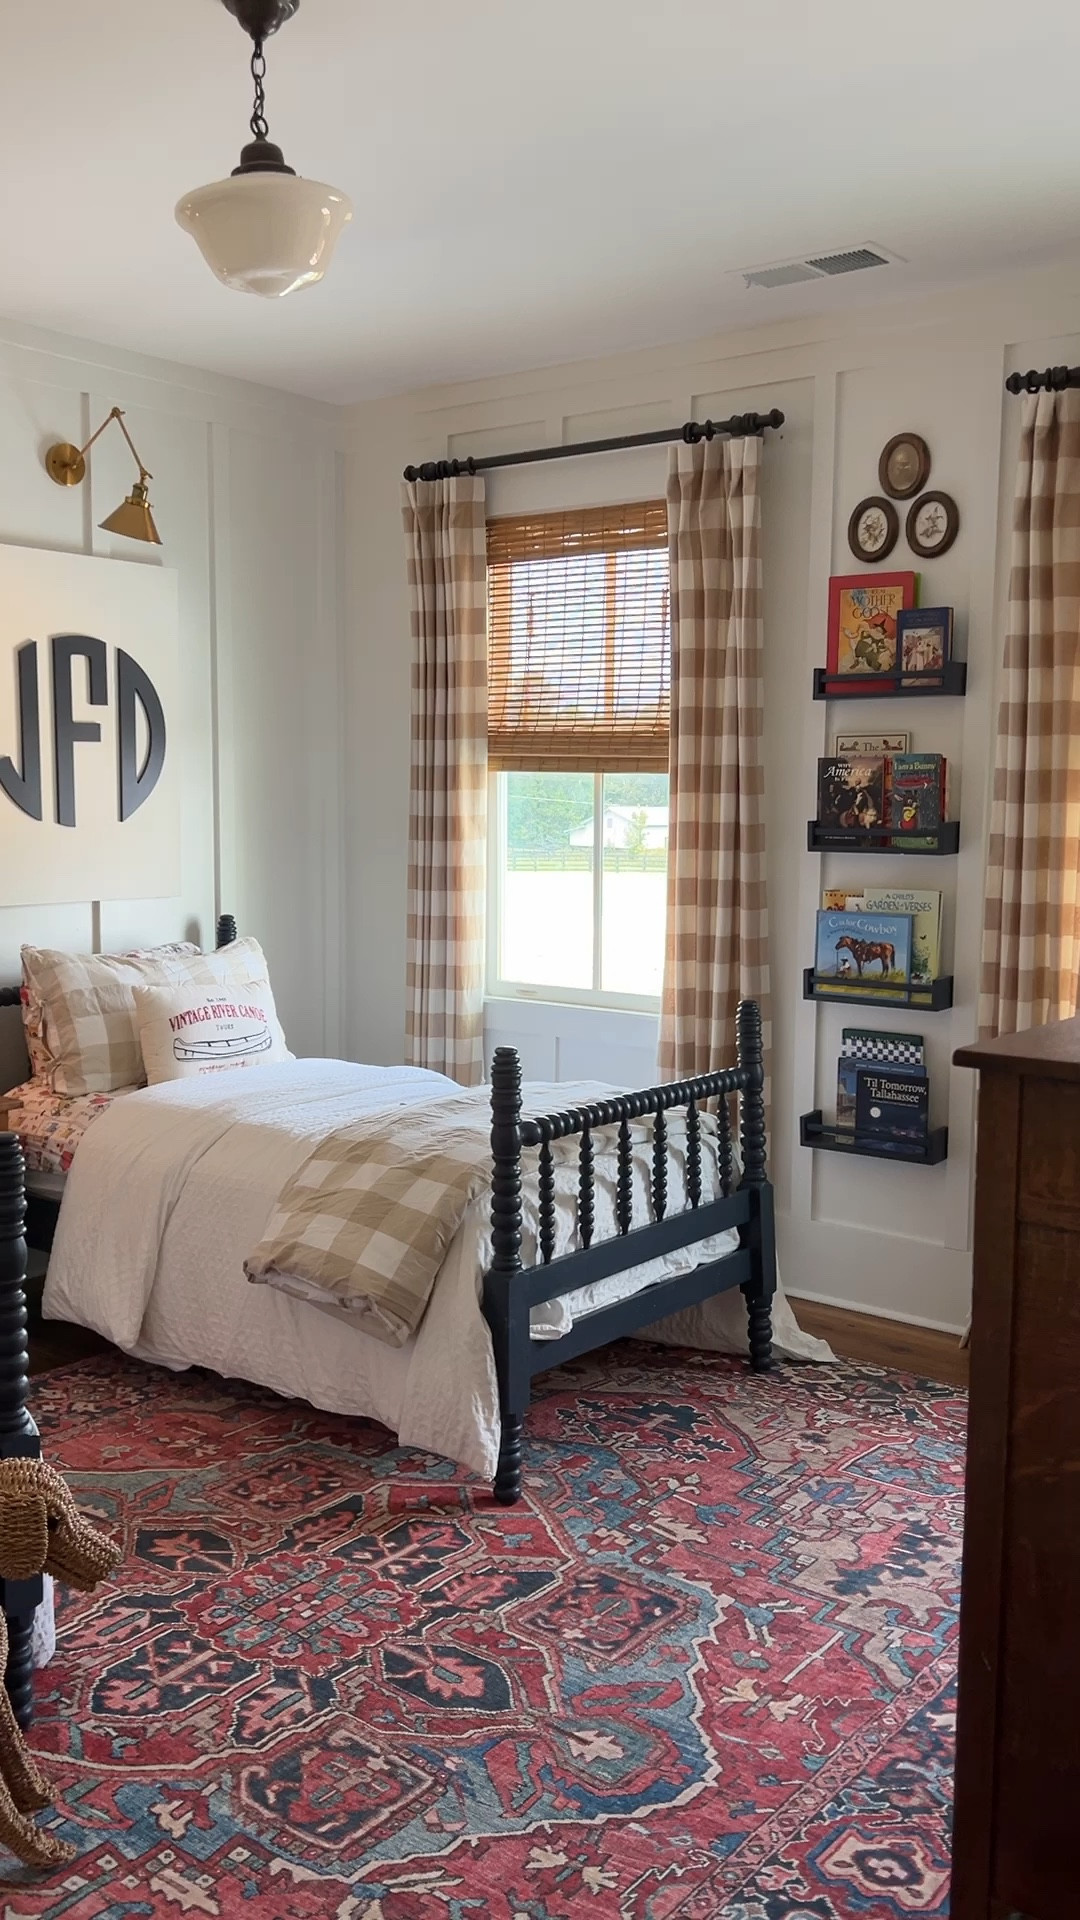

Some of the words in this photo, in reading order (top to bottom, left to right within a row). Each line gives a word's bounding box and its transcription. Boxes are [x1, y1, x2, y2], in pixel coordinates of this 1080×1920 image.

[862, 742, 880, 751] The
[823, 765, 873, 779] America
[866, 900, 899, 911] GARDEN
[904, 901, 932, 912] VERSES
[856, 918, 897, 936] Cowboy
[168, 1006, 211, 1032] VINTAGE
[210, 1004, 239, 1019] RIVER
[239, 1004, 267, 1023] CANOE
[869, 1087, 919, 1103] Tallahassee
[879, 1079, 927, 1095] Tomorrow,
